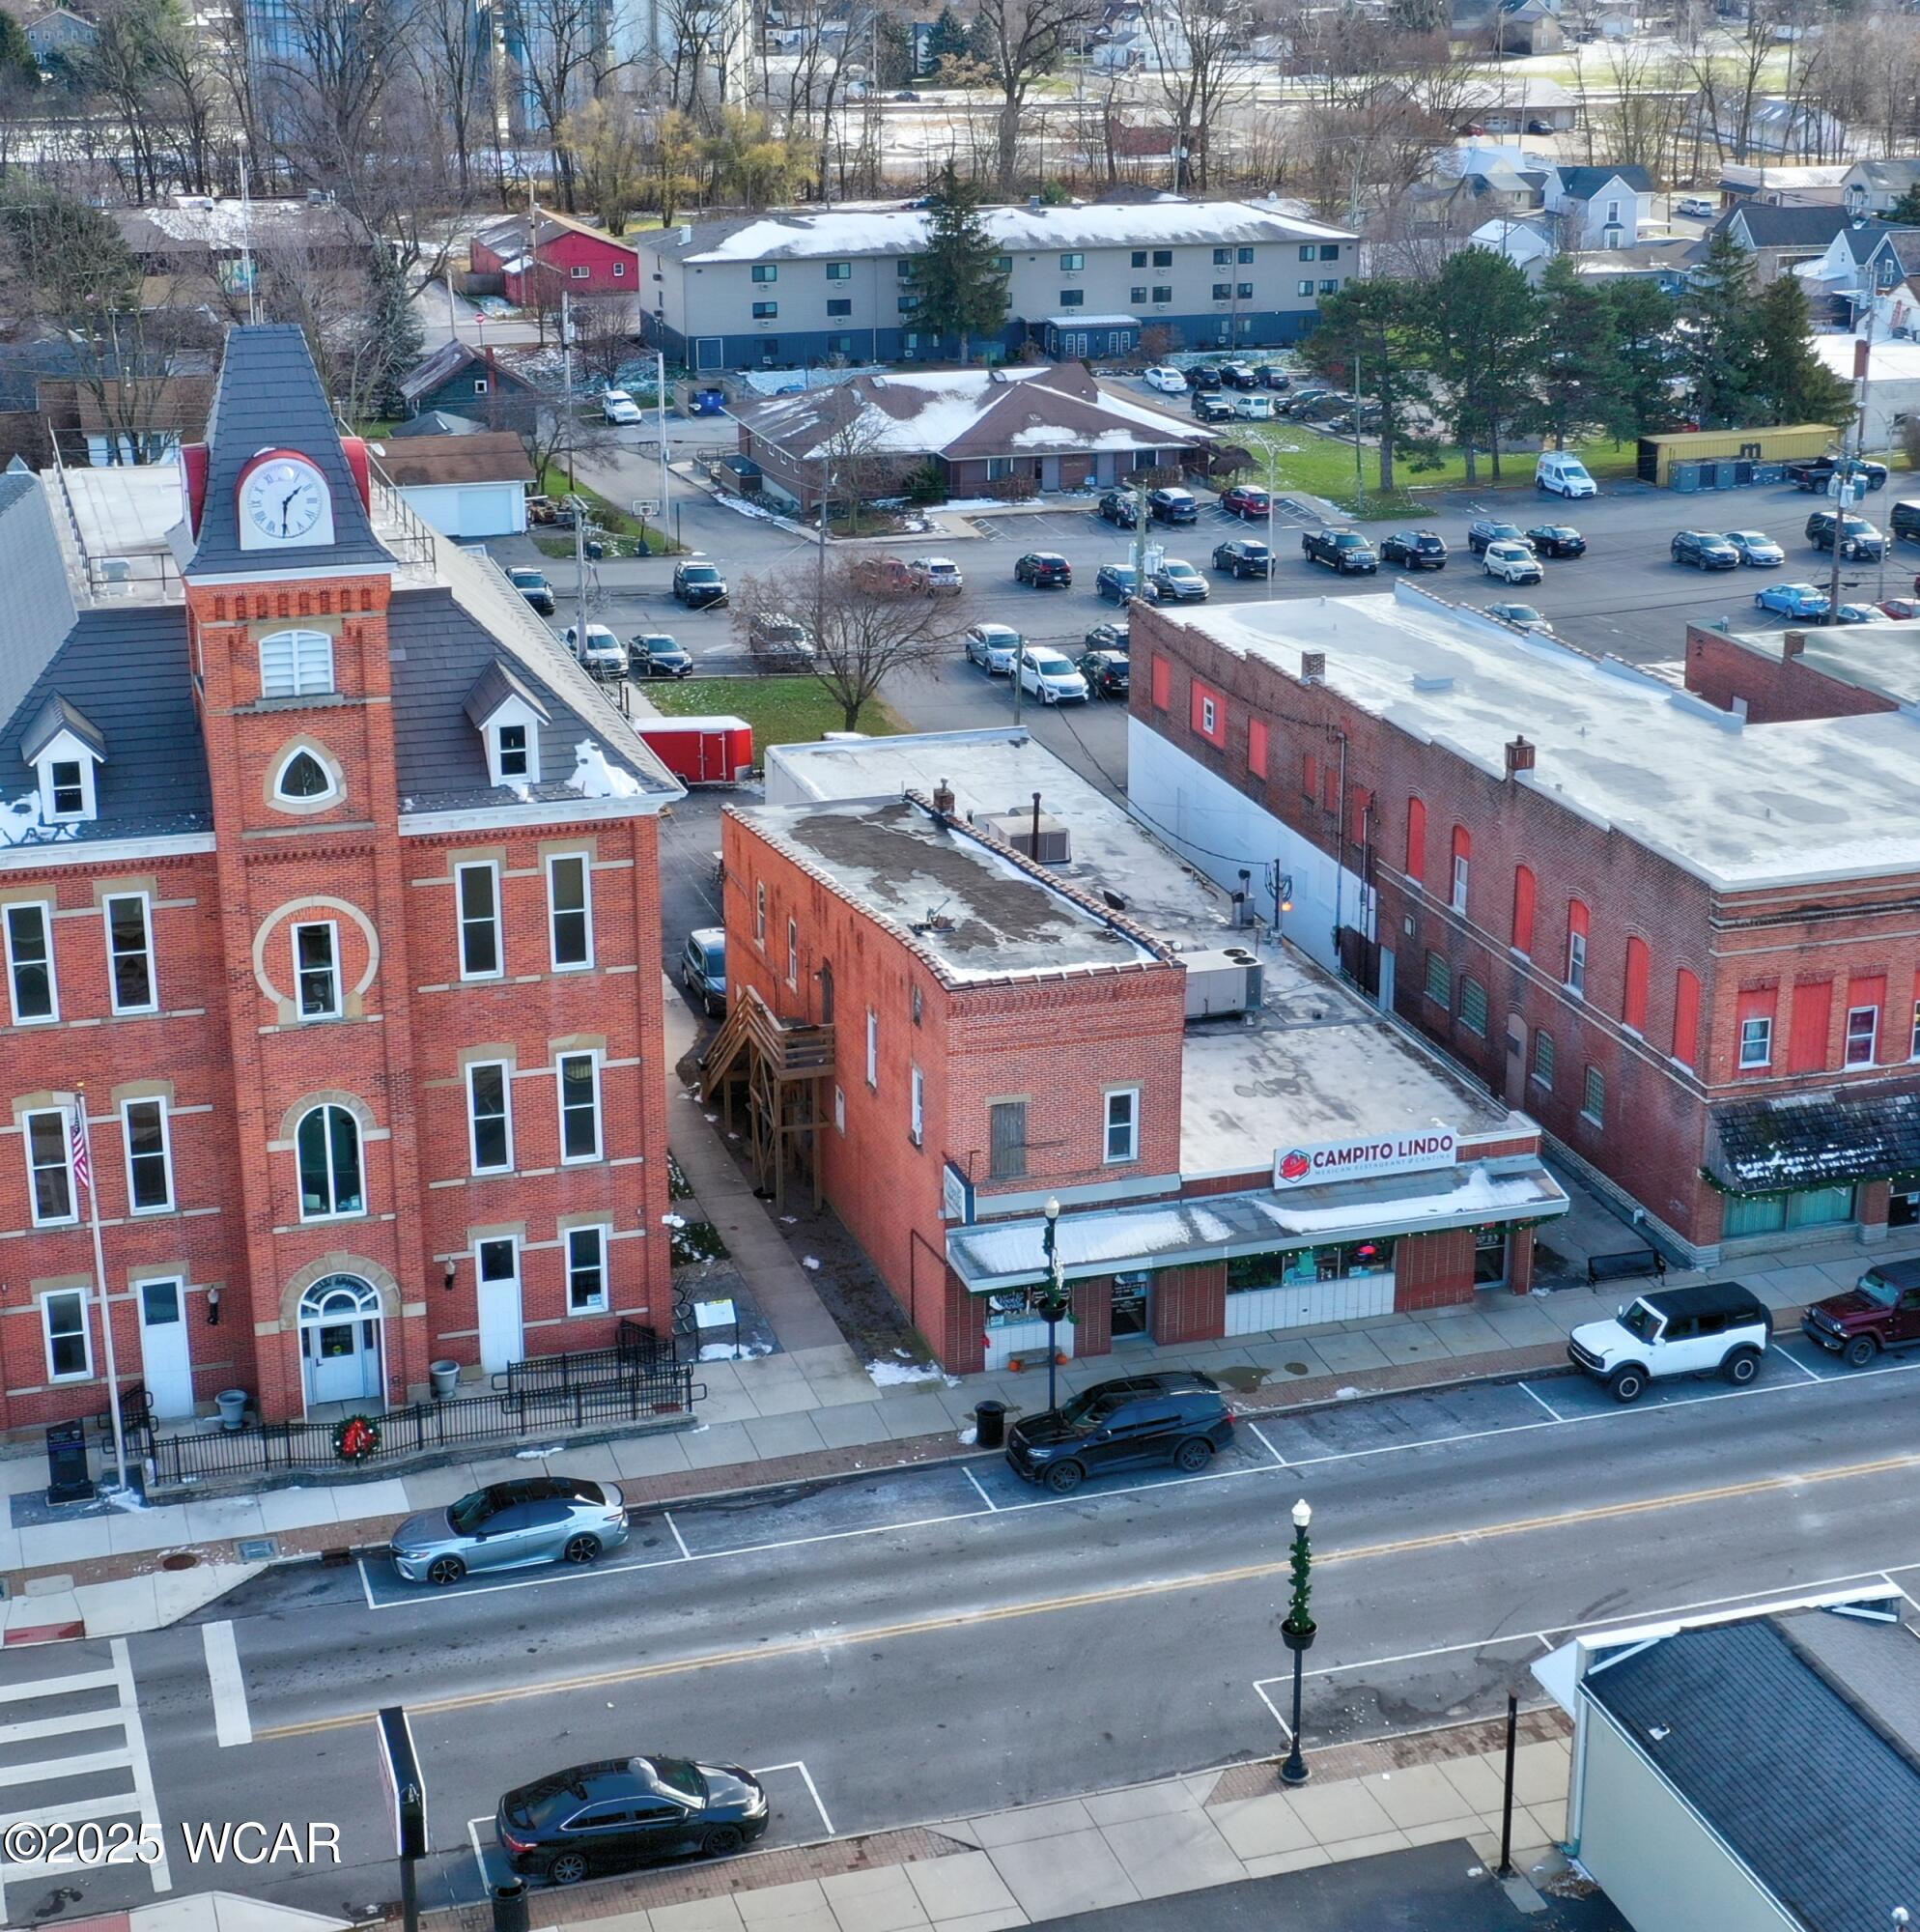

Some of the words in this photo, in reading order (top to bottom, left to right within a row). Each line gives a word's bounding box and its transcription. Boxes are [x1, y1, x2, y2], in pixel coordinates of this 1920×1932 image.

[1313, 1143, 1394, 1168] CAMPITO
[1398, 1135, 1454, 1157] LINDO
[1313, 1167, 1351, 1176] MEXICAN
